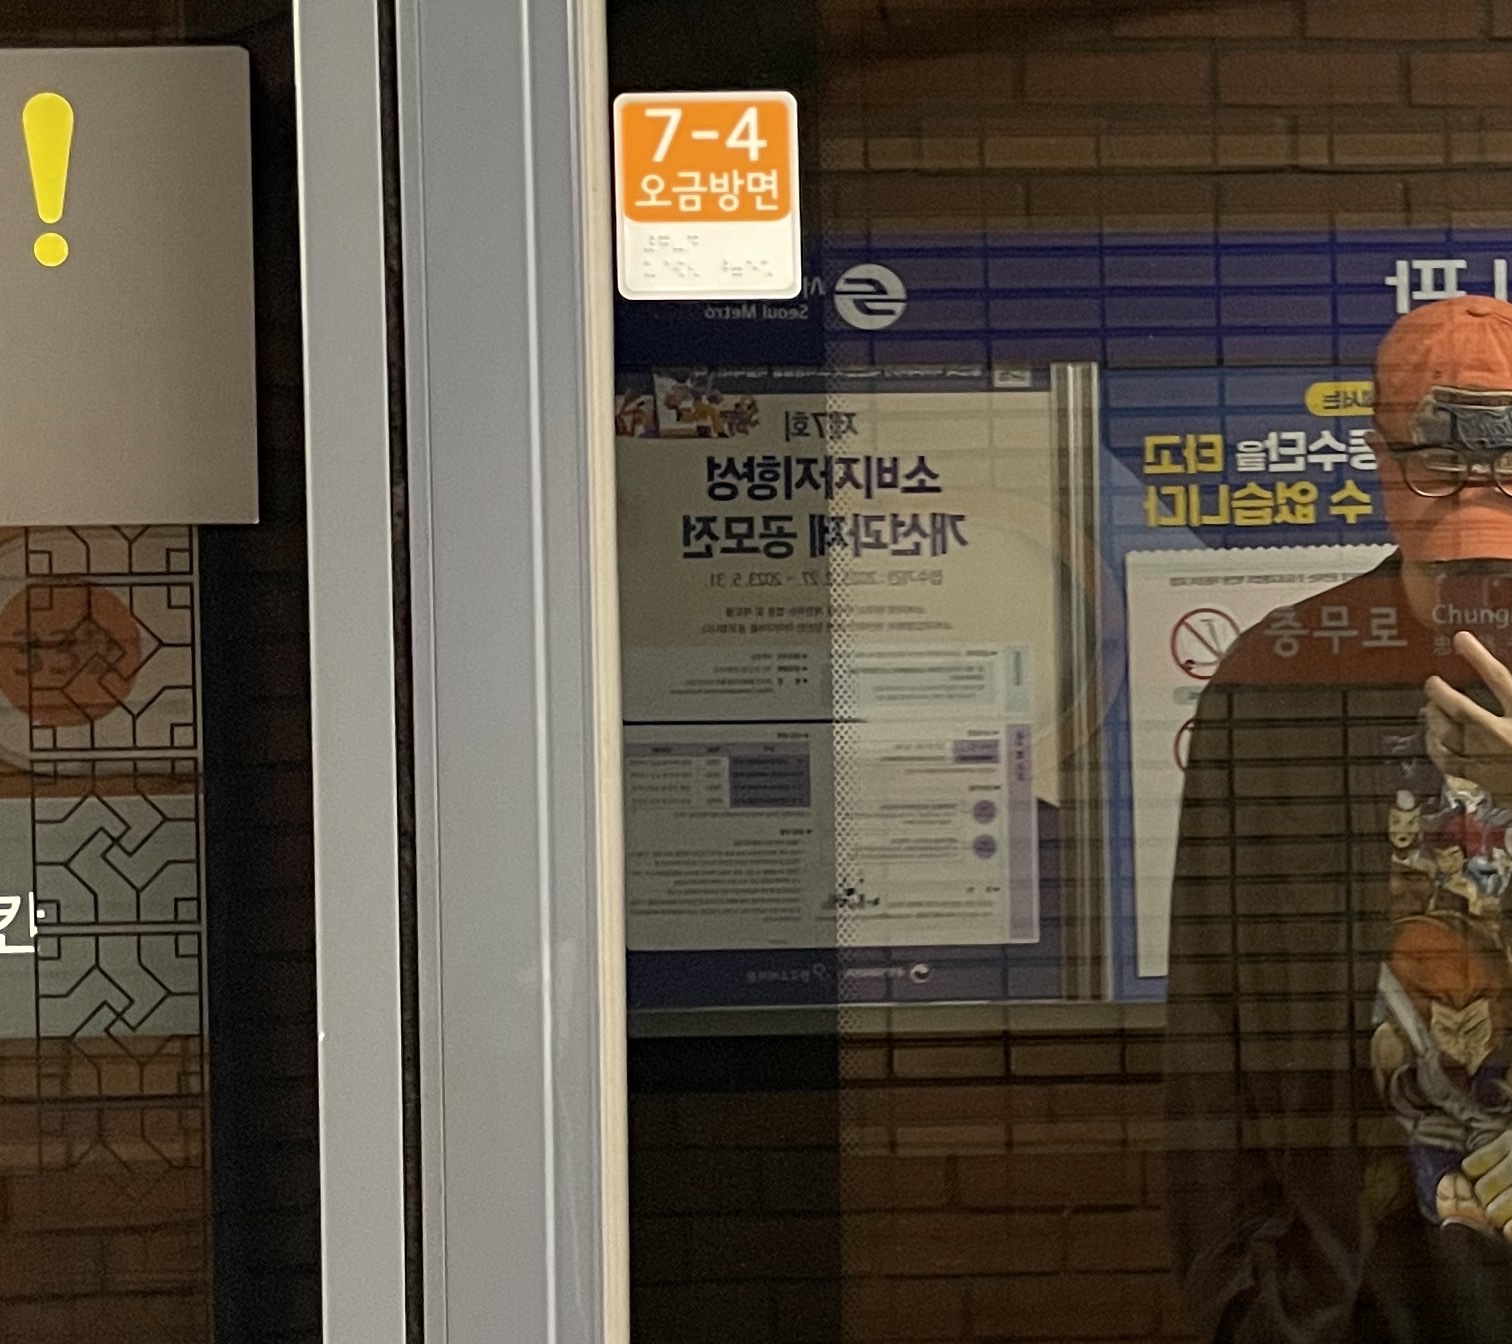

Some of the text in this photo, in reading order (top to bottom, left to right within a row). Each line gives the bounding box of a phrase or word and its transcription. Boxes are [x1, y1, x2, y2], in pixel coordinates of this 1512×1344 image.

[643, 106, 768, 163] 7-4
[634, 168, 780, 213] 오금방면
[1264, 605, 1408, 659] 충무로
